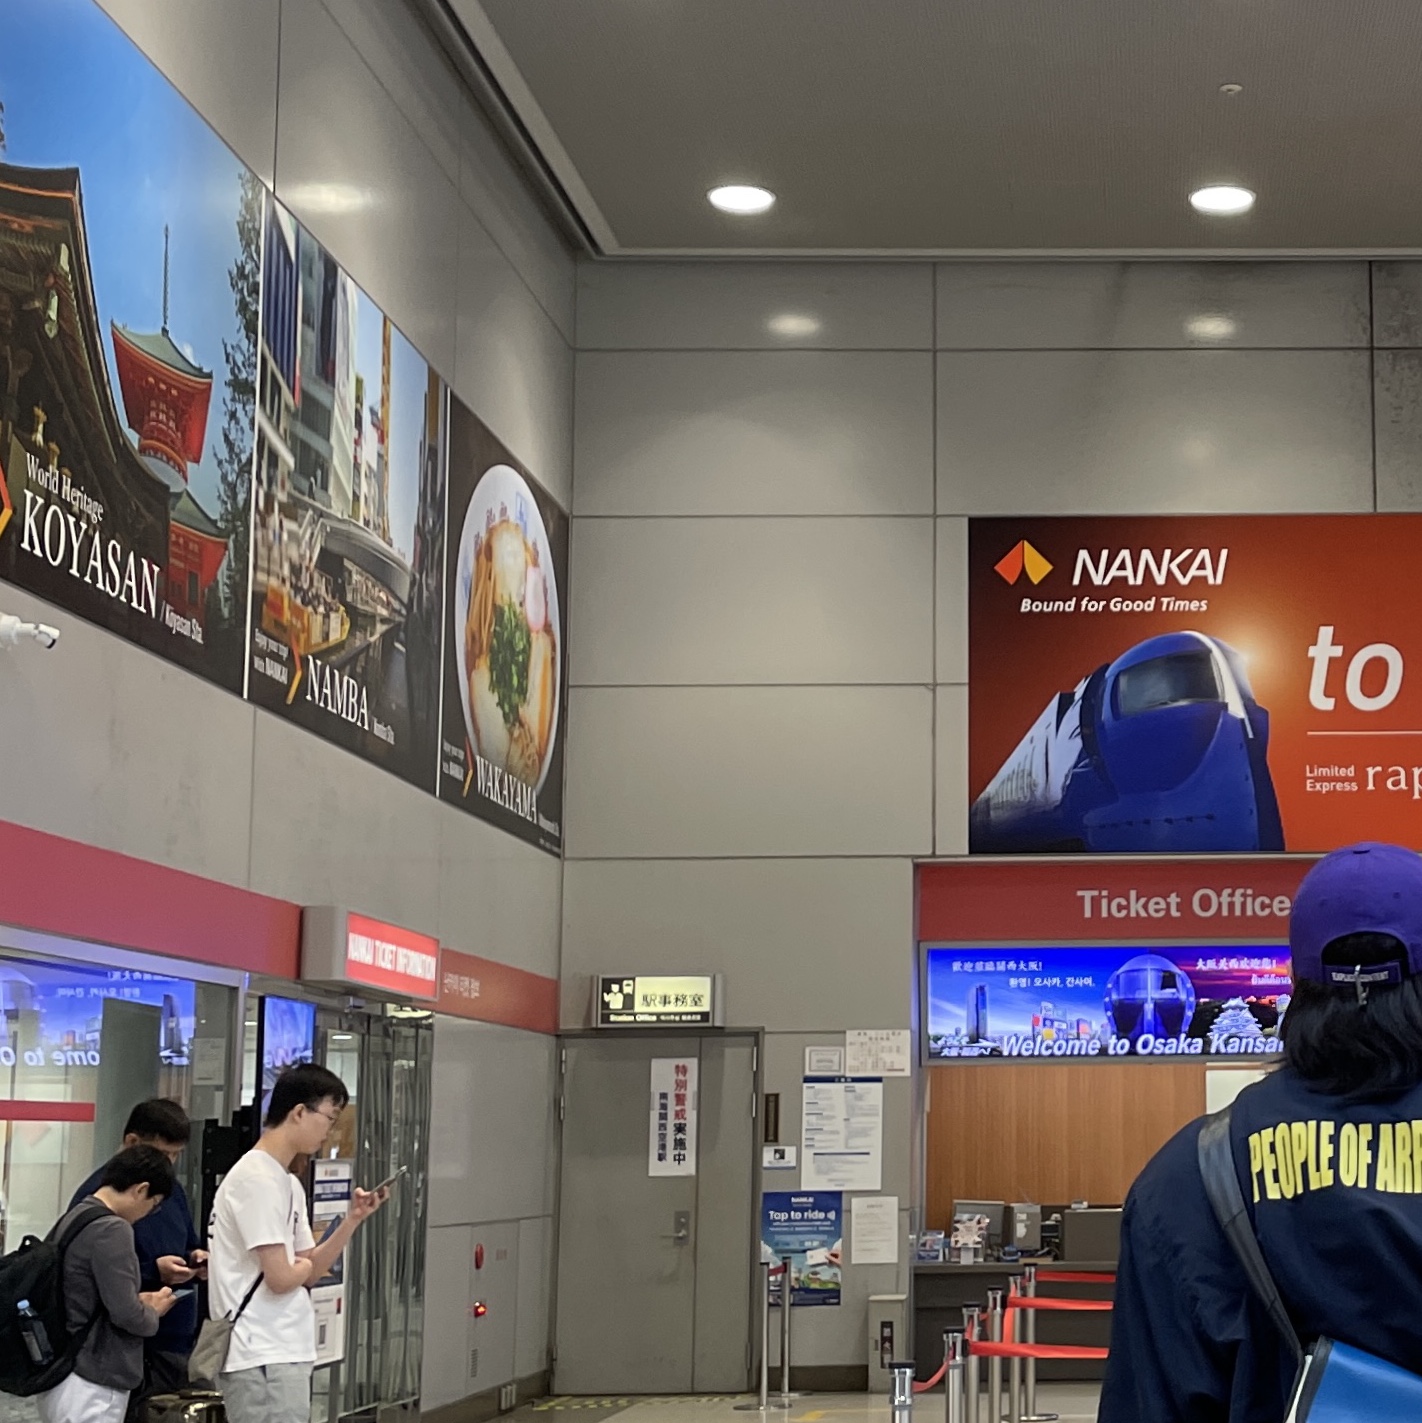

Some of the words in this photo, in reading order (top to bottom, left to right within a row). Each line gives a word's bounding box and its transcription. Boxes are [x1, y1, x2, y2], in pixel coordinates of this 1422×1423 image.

[27, 452, 60, 494] World
[62, 475, 104, 524] Heritage
[20, 489, 160, 619] KOYASAN
[1072, 548, 1229, 585] NANKAI
[1020, 597, 1076, 613] Bound
[1081, 597, 1108, 612] for
[1109, 597, 1155, 612] Good
[1161, 597, 1208, 612] Times
[1307, 625, 1404, 711] to
[306, 654, 369, 731] NAMBA
[1306, 764, 1355, 777] Limited
[1306, 779, 1358, 793] Express
[476, 754, 538, 825] WAKAYAMA
[1077, 888, 1181, 918] Ticket
[1192, 887, 1291, 917] Office
[1002, 1034, 1100, 1057] Welcome
[1108, 1034, 1130, 1055] to
[1136, 1033, 1203, 1055] Osaka
[1248, 1120, 1335, 1203] PEOPLE
[1339, 1122, 1373, 1189] OF
[768, 1210, 789, 1222] Tap
[790, 1210, 802, 1220] to
[804, 1209, 825, 1220] ride
